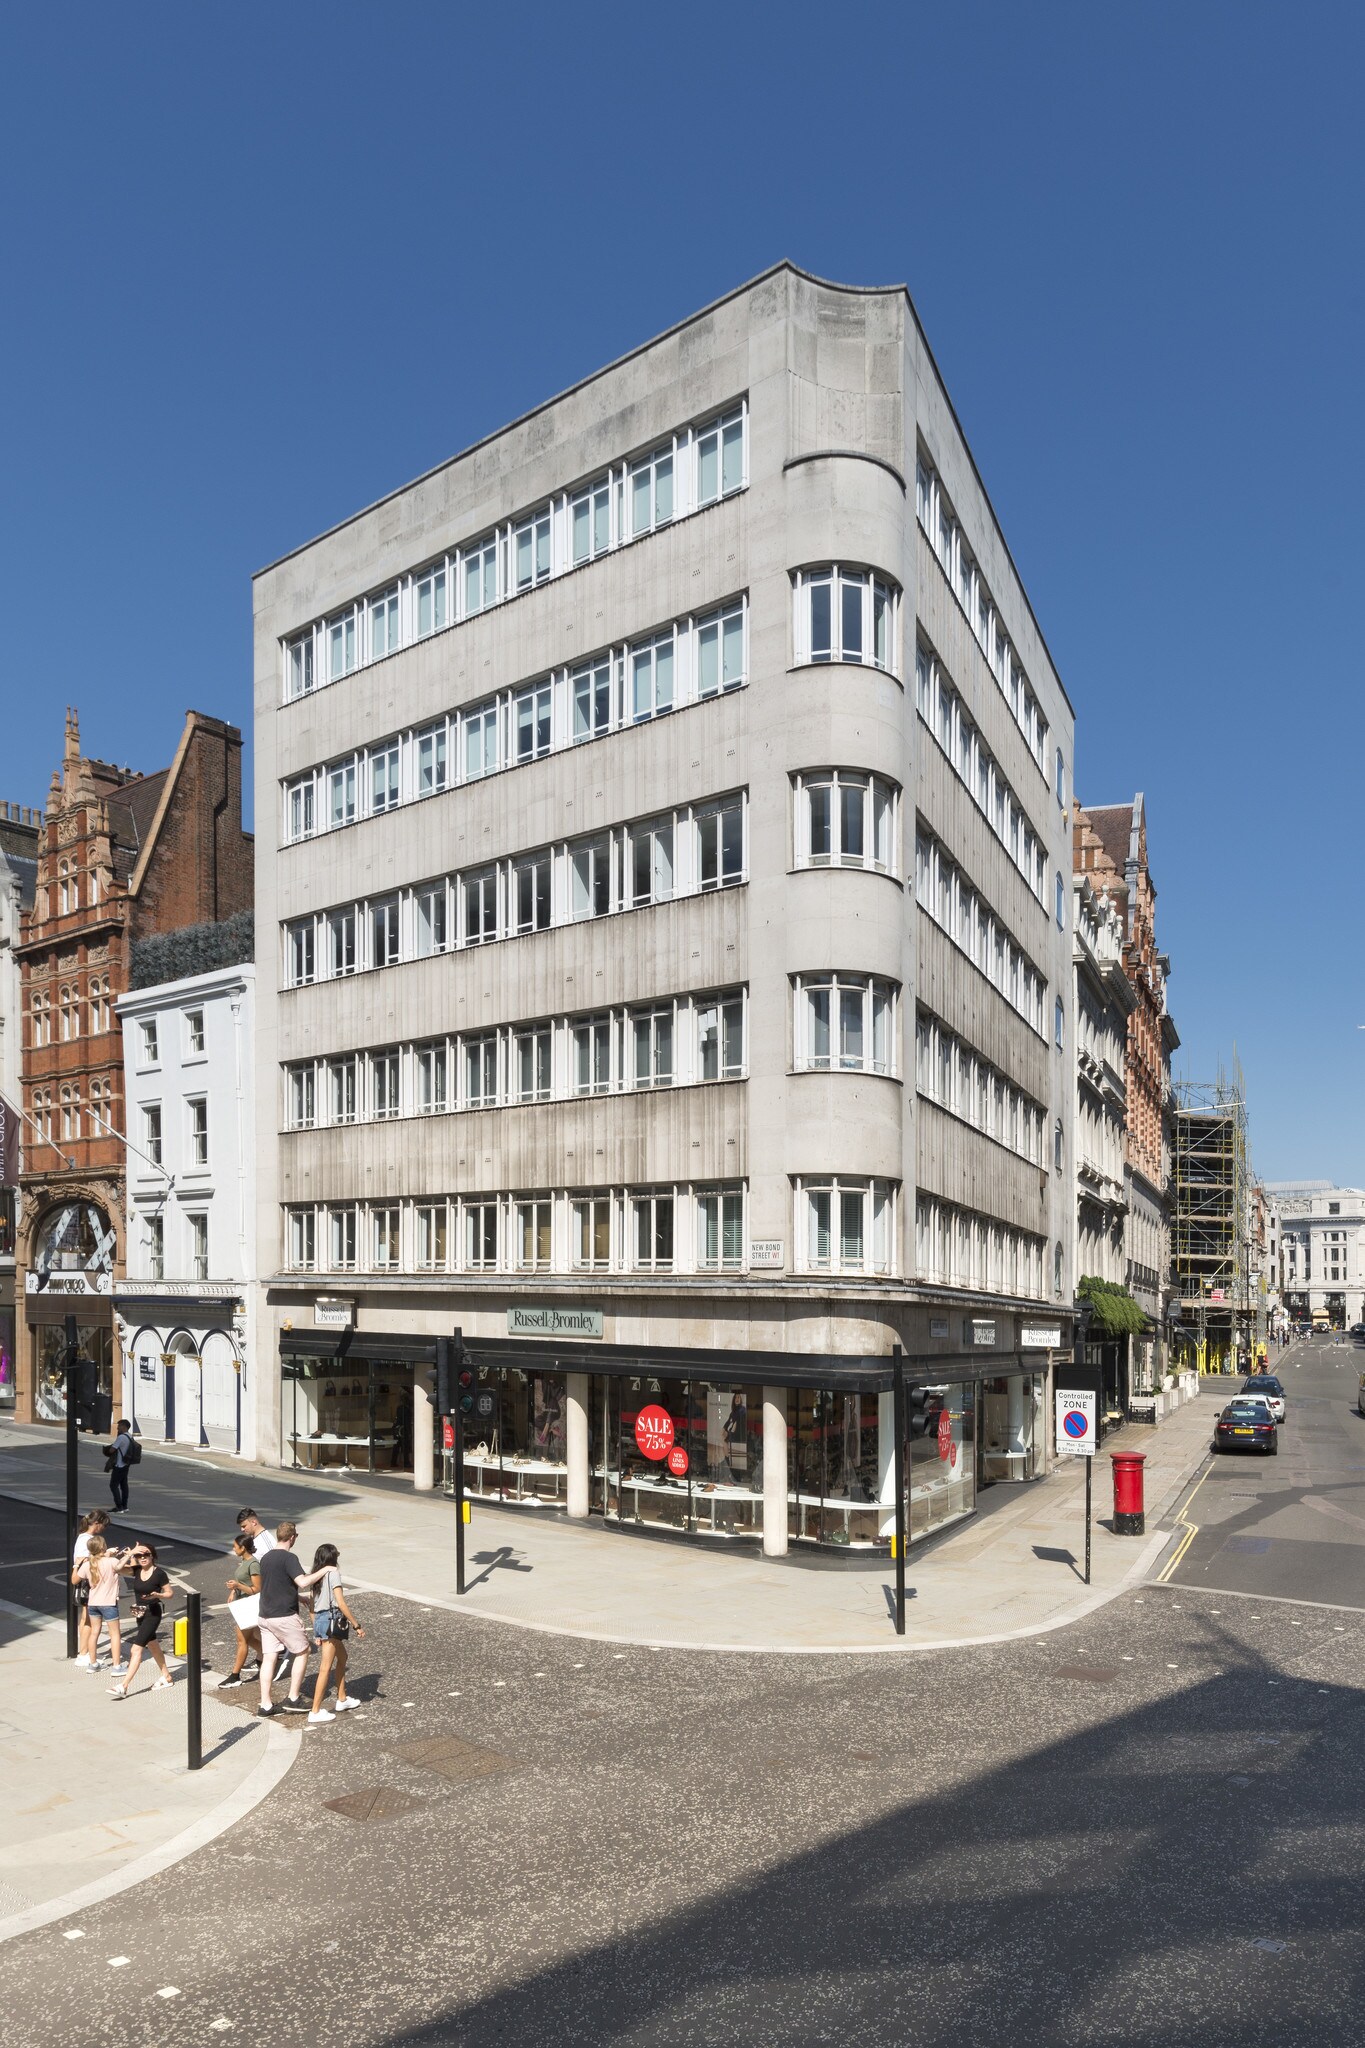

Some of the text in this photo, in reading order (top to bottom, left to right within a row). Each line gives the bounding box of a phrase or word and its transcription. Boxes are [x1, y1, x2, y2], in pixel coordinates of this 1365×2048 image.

[514, 1310, 548, 1327] Russell
[553, 1311, 595, 1331] Bromley
[1058, 1392, 1093, 1400] Controlled
[1063, 1400, 1088, 1409] ZONE
[637, 1416, 672, 1435] SALE
[645, 1433, 667, 1450] 75%
